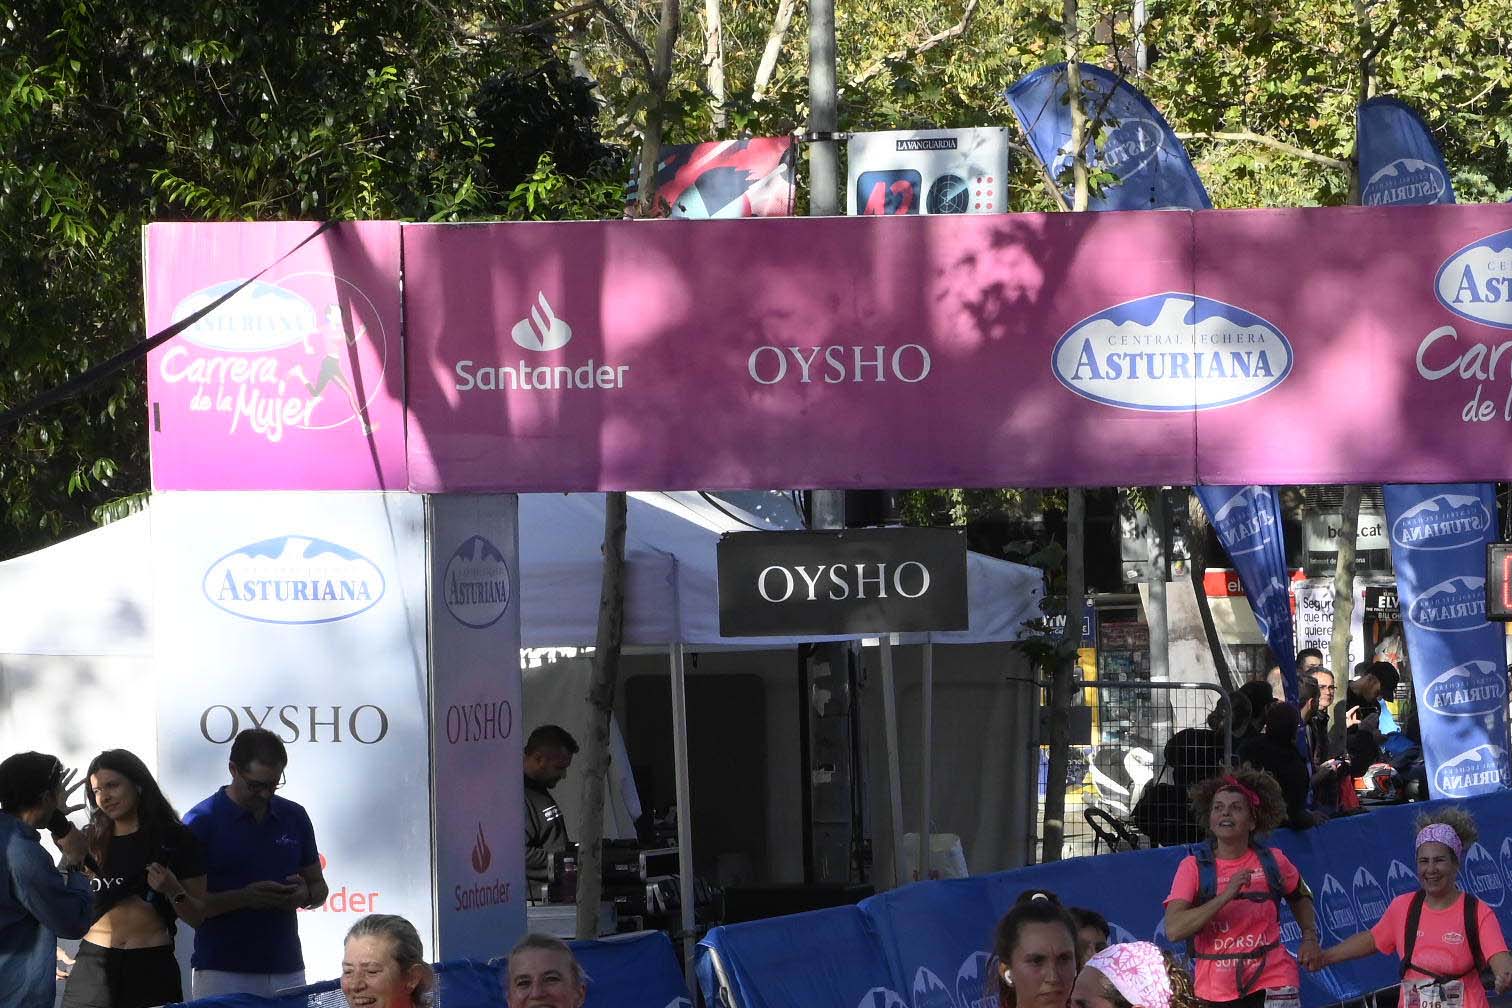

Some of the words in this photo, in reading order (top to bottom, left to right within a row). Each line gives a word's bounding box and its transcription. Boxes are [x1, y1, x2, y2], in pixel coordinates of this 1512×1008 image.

[1108, 335, 1183, 346] CENTRAL
[1190, 332, 1266, 345] LECHERA
[160, 346, 278, 384] Carrera
[456, 360, 628, 390] Santander
[747, 344, 930, 385] OYSHO
[1071, 337, 1275, 382] ASTURIANA
[190, 385, 211, 411] de
[216, 386, 232, 411] la
[230, 380, 323, 442] Mujer
[1462, 386, 1496, 422] de
[217, 569, 371, 601] ASTURIANA
[450, 571, 506, 604] ASTURIANA
[757, 561, 930, 603] OYSHO
[201, 704, 388, 744] OYSHO
[447, 700, 512, 744] OYSHO
[455, 881, 511, 911] Santander
[1214, 935, 1269, 950] DORSAL
[1422, 1001, 1441, 1008] 016
